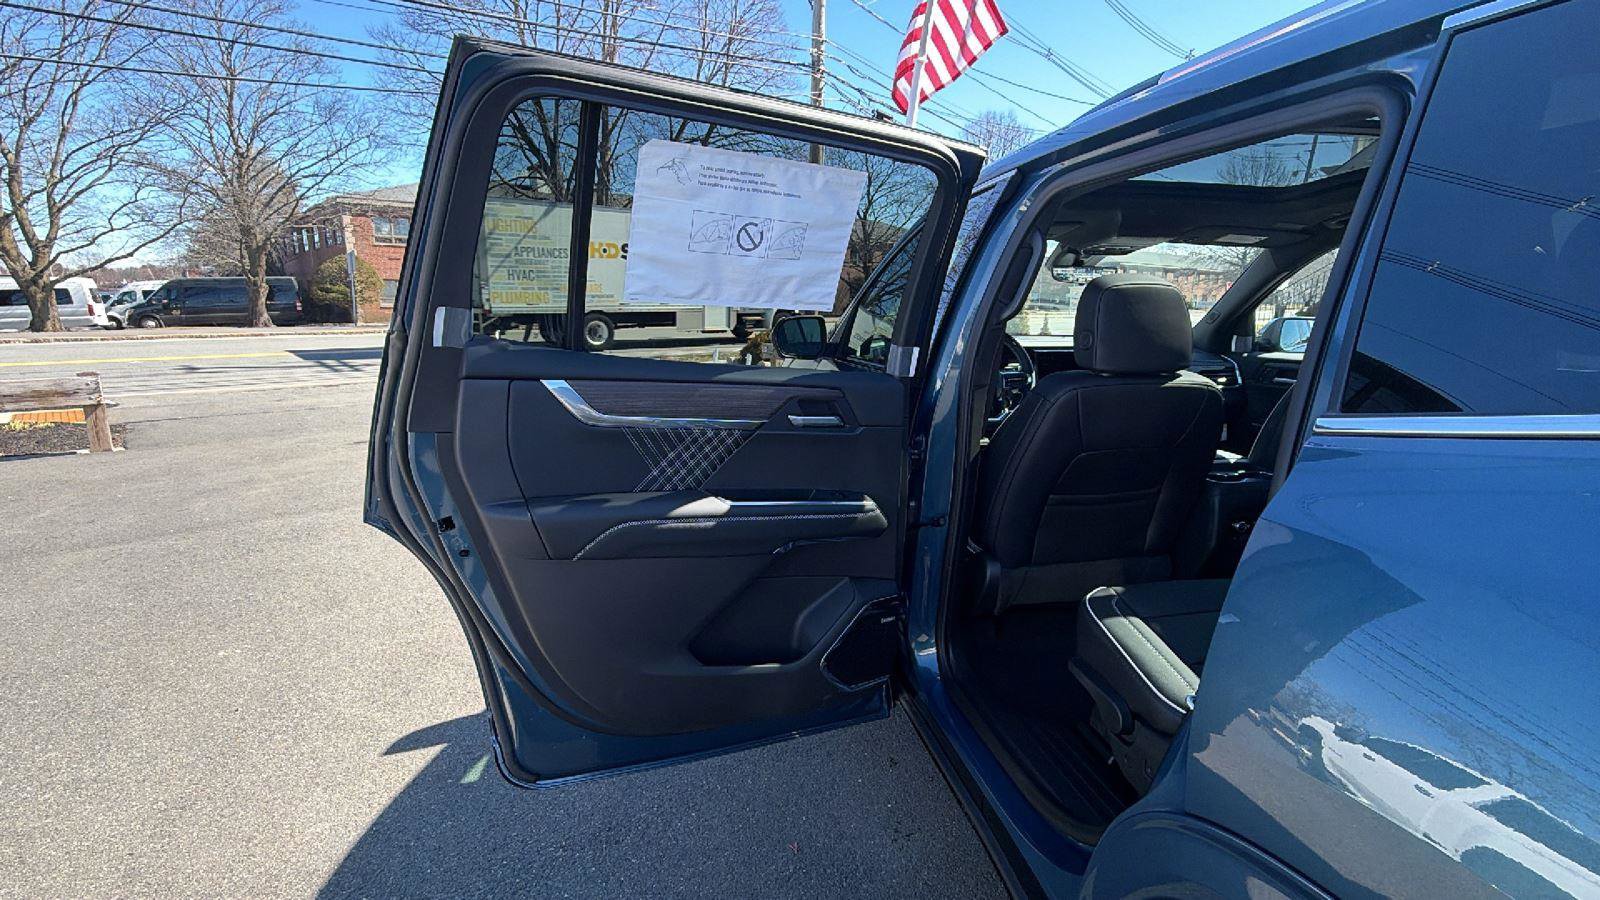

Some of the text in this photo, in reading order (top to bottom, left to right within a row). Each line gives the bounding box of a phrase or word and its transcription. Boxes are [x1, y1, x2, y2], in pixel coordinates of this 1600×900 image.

[513, 246, 569, 259] APPLIANCES
[507, 269, 536, 282] HVAC
[491, 291, 550, 305] PLUMBING
